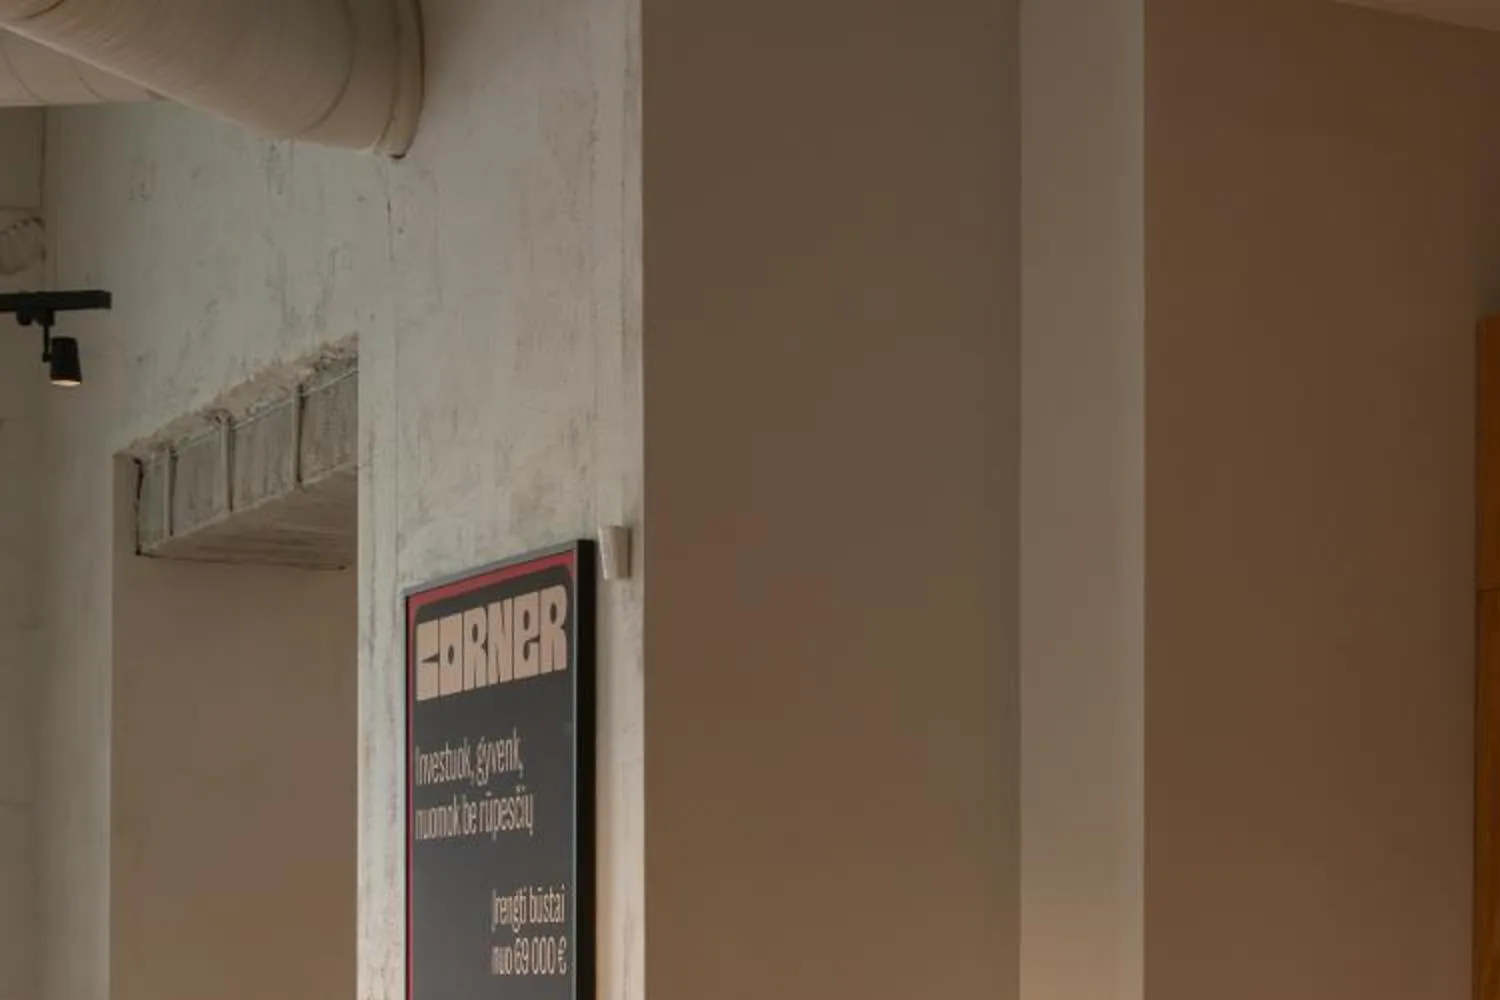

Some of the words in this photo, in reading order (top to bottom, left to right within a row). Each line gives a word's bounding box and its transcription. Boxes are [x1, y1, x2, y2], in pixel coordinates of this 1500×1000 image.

[415, 736, 474, 787] Investuok,
[476, 728, 524, 787] gyvenk,
[415, 794, 460, 840] nuomok
[463, 793, 477, 835] be
[479, 784, 534, 841] rūpesčių
[530, 884, 565, 924] būstai
[492, 946, 513, 975] nuo
[515, 937, 529, 975] 69
[531, 936, 556, 975] 000
[557, 935, 568, 976] €
